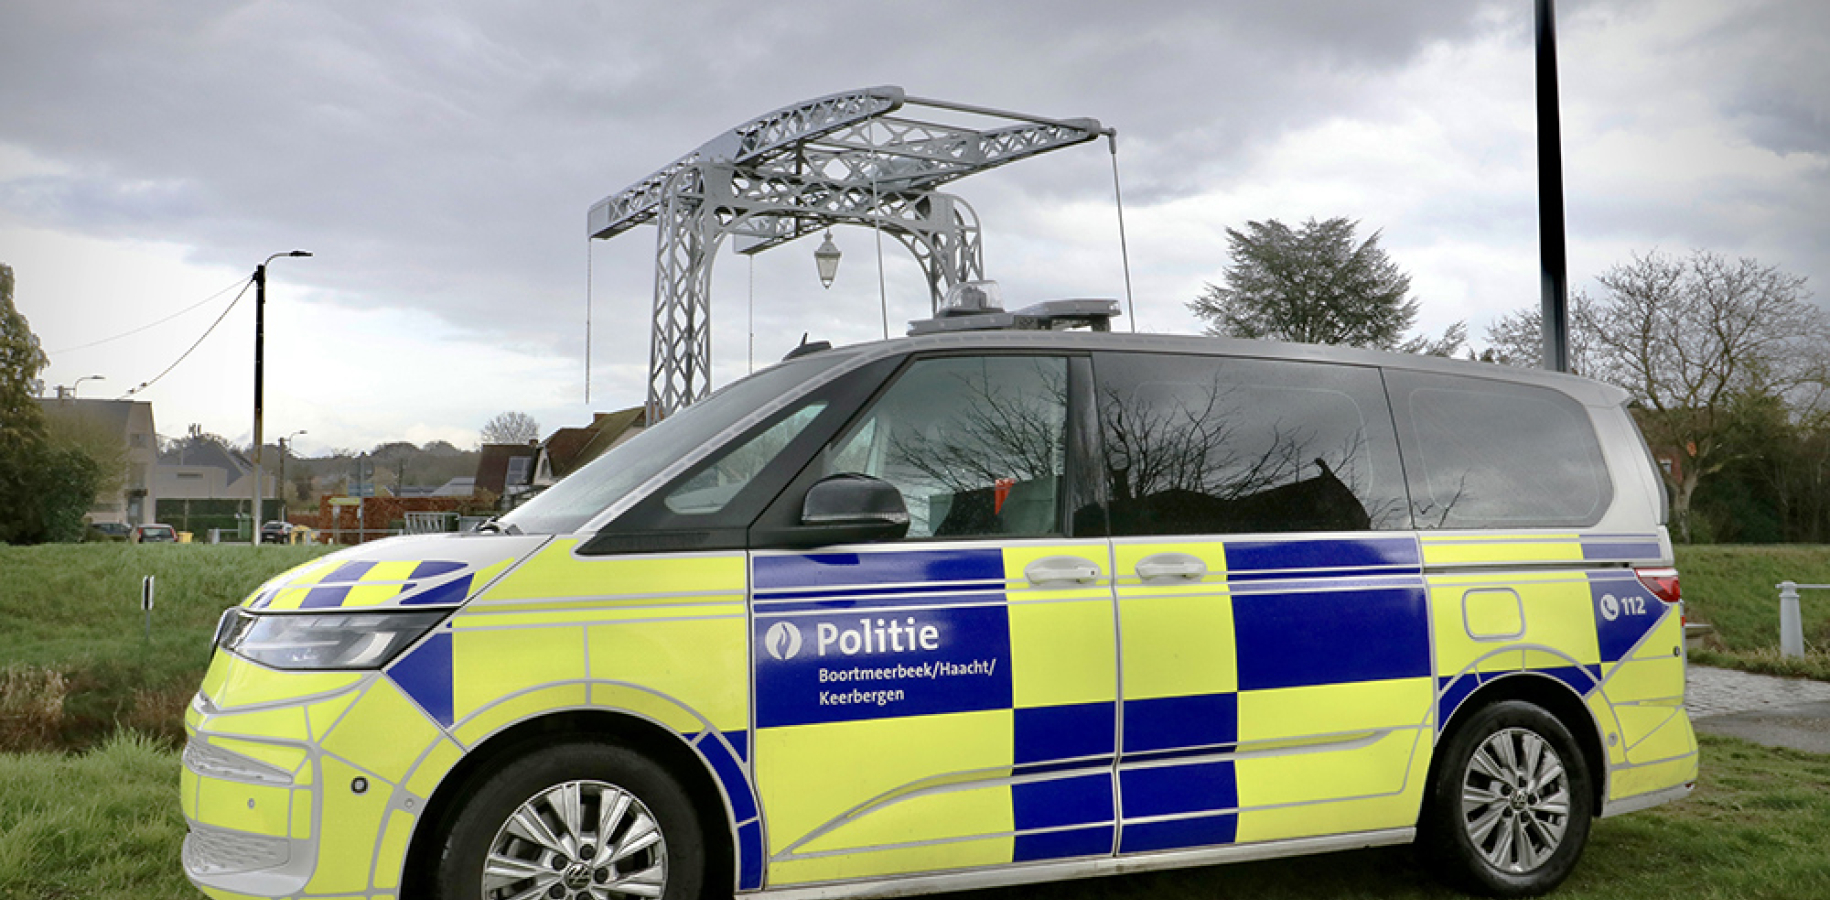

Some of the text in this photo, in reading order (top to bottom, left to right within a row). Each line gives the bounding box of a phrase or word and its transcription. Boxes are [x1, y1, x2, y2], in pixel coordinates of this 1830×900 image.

[1621, 596, 1646, 615] 112
[817, 617, 939, 656] Politie
[819, 659, 996, 682] Boortmeerbeek/Haacht/
[819, 688, 904, 705] Keerbergen
